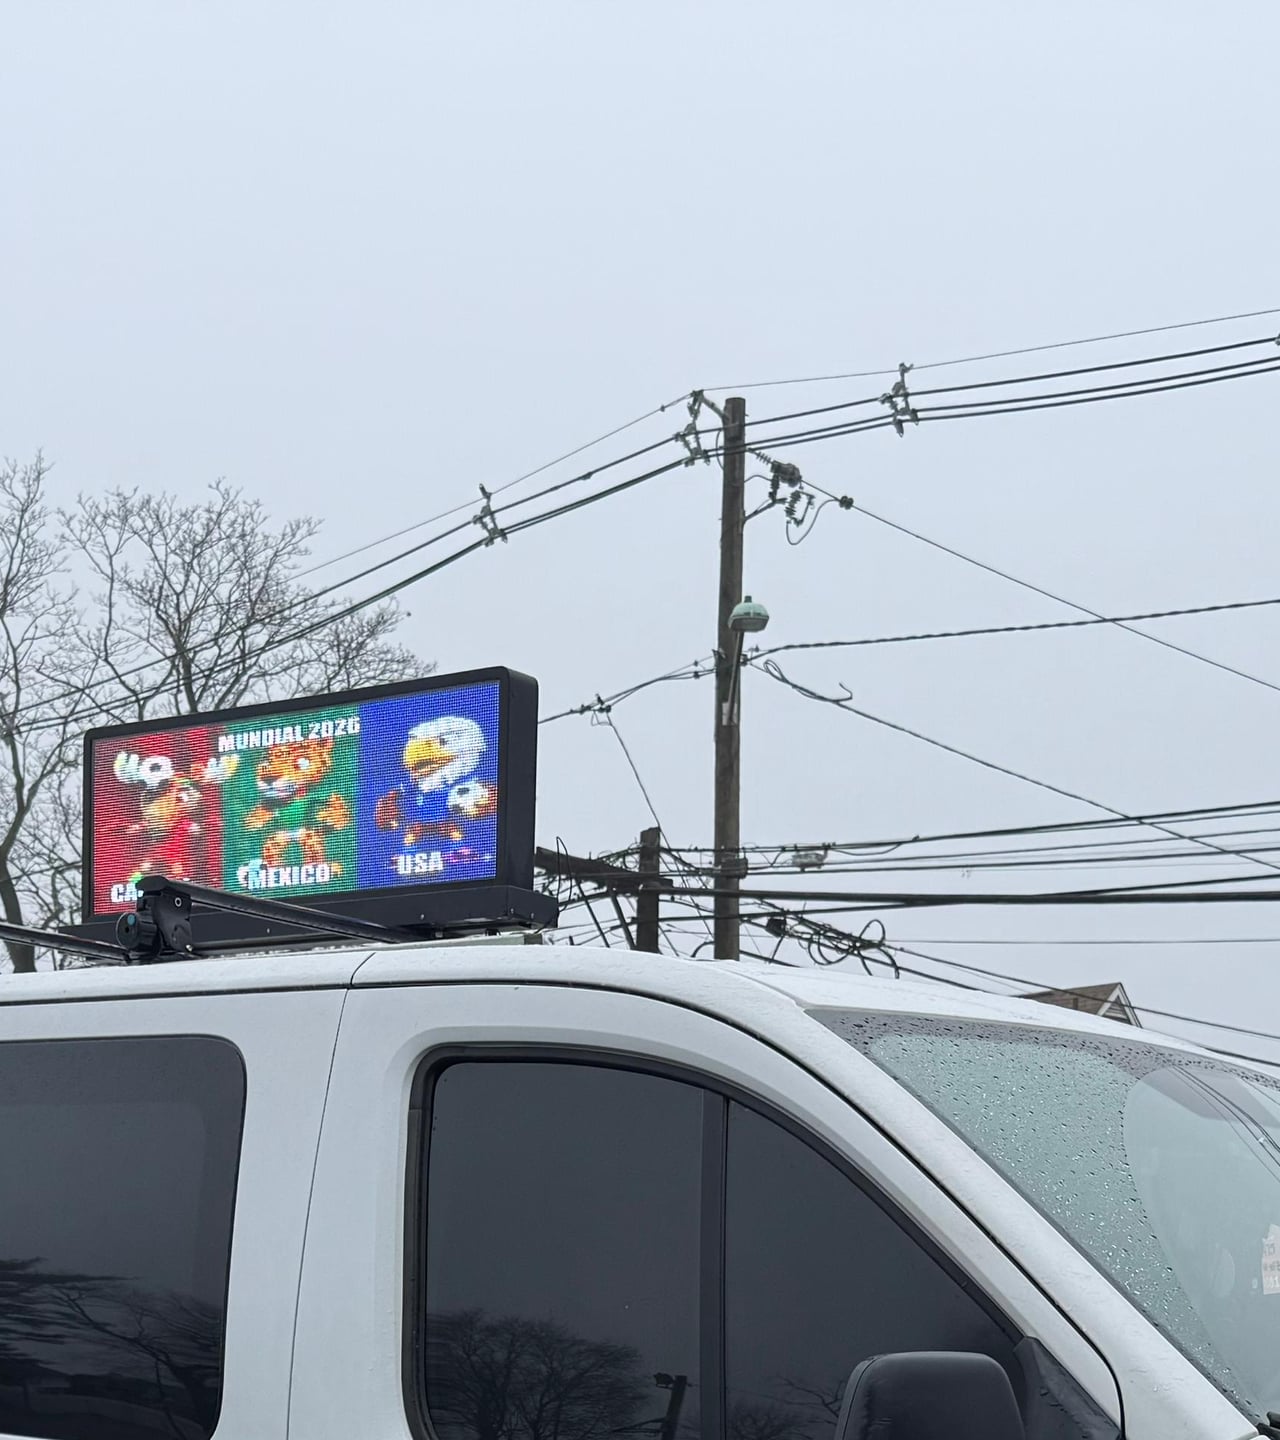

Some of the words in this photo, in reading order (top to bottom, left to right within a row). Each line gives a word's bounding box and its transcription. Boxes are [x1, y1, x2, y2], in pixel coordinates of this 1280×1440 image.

[218, 723, 304, 752] MUNDIAL
[308, 716, 361, 740] 2026
[247, 863, 331, 890] MEXICO
[398, 852, 443, 874] USA
